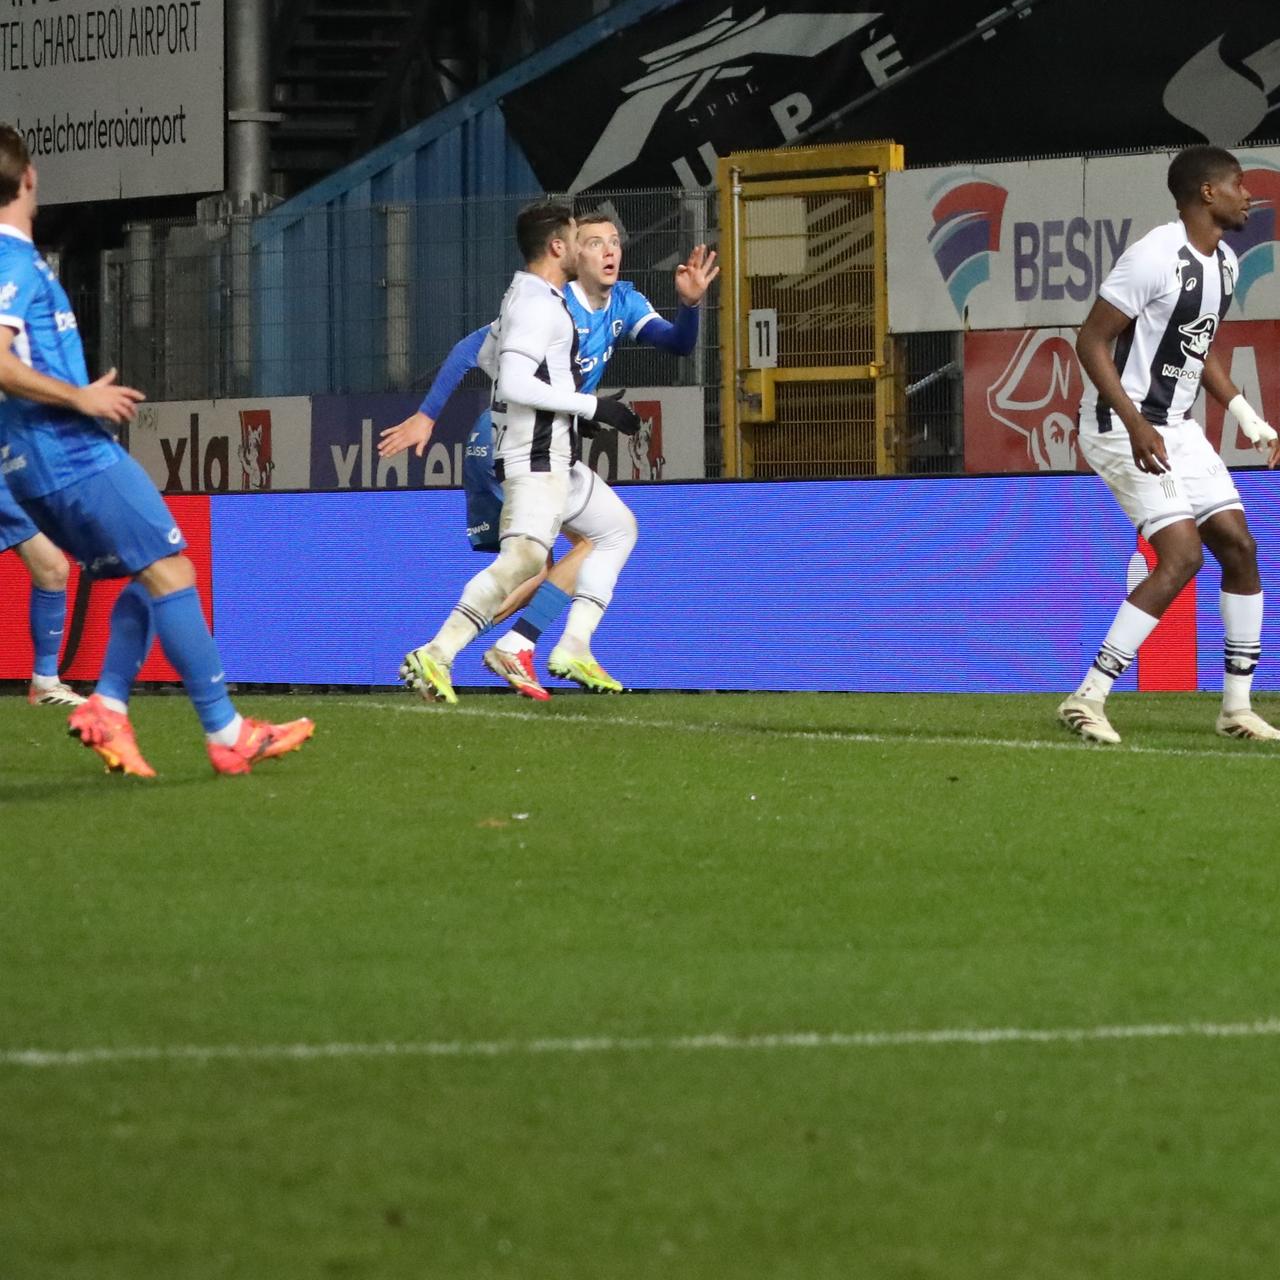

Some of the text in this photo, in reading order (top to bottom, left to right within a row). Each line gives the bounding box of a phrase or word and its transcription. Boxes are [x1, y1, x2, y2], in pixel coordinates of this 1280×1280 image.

[33, 8, 123, 68] CHARLEROI
[128, 1, 200, 57] AIRPORT
[1013, 217, 1132, 302] BESIX
[755, 321, 770, 357] 11
[1161, 363, 1201, 380] NAPOL
